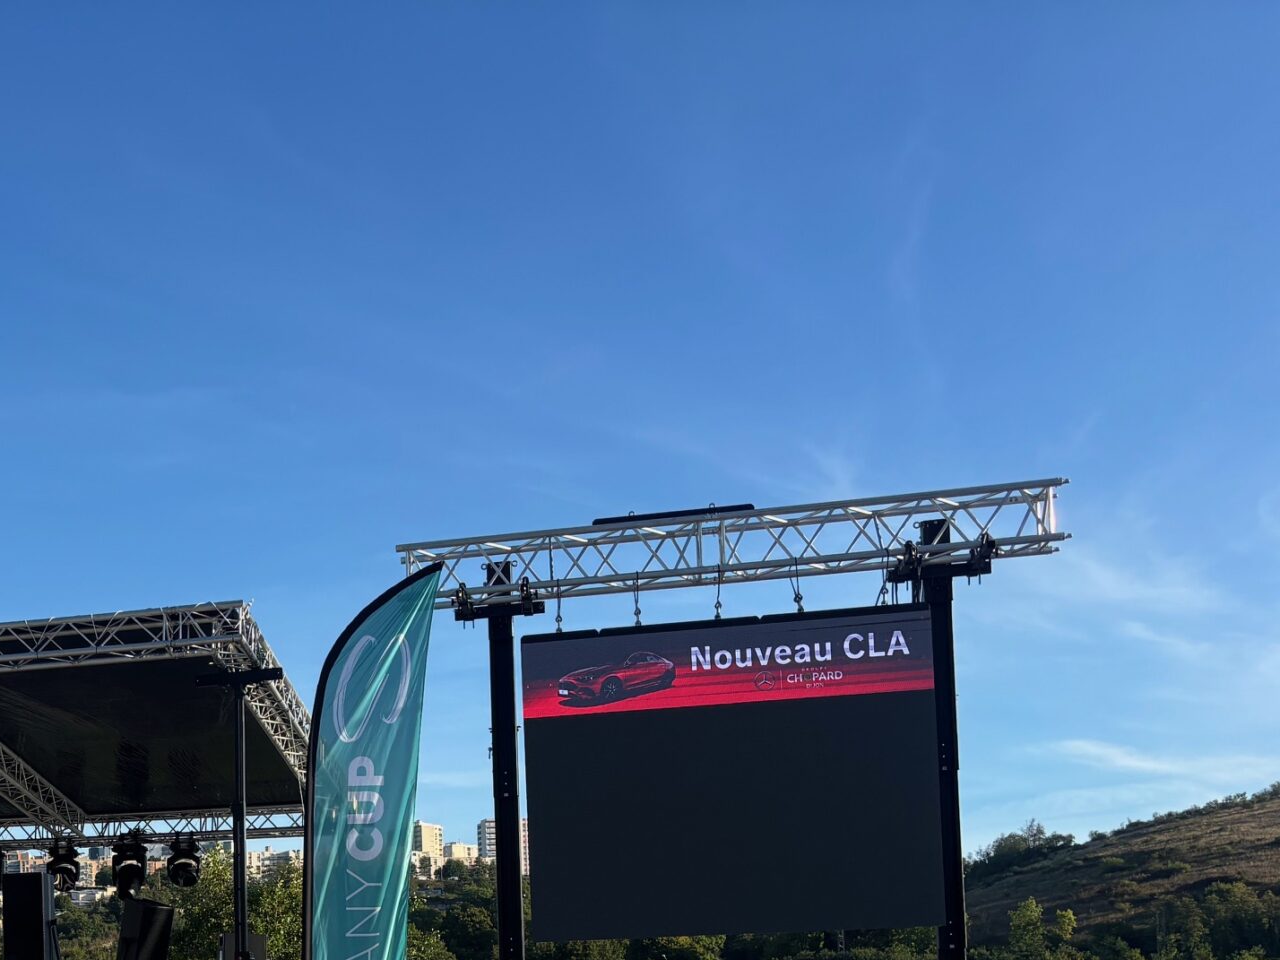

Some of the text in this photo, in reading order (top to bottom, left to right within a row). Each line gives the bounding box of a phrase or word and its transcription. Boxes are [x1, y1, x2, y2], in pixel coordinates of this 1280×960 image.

[690, 630, 910, 671] Nouveau CLA
[346, 755, 385, 862] CUP
